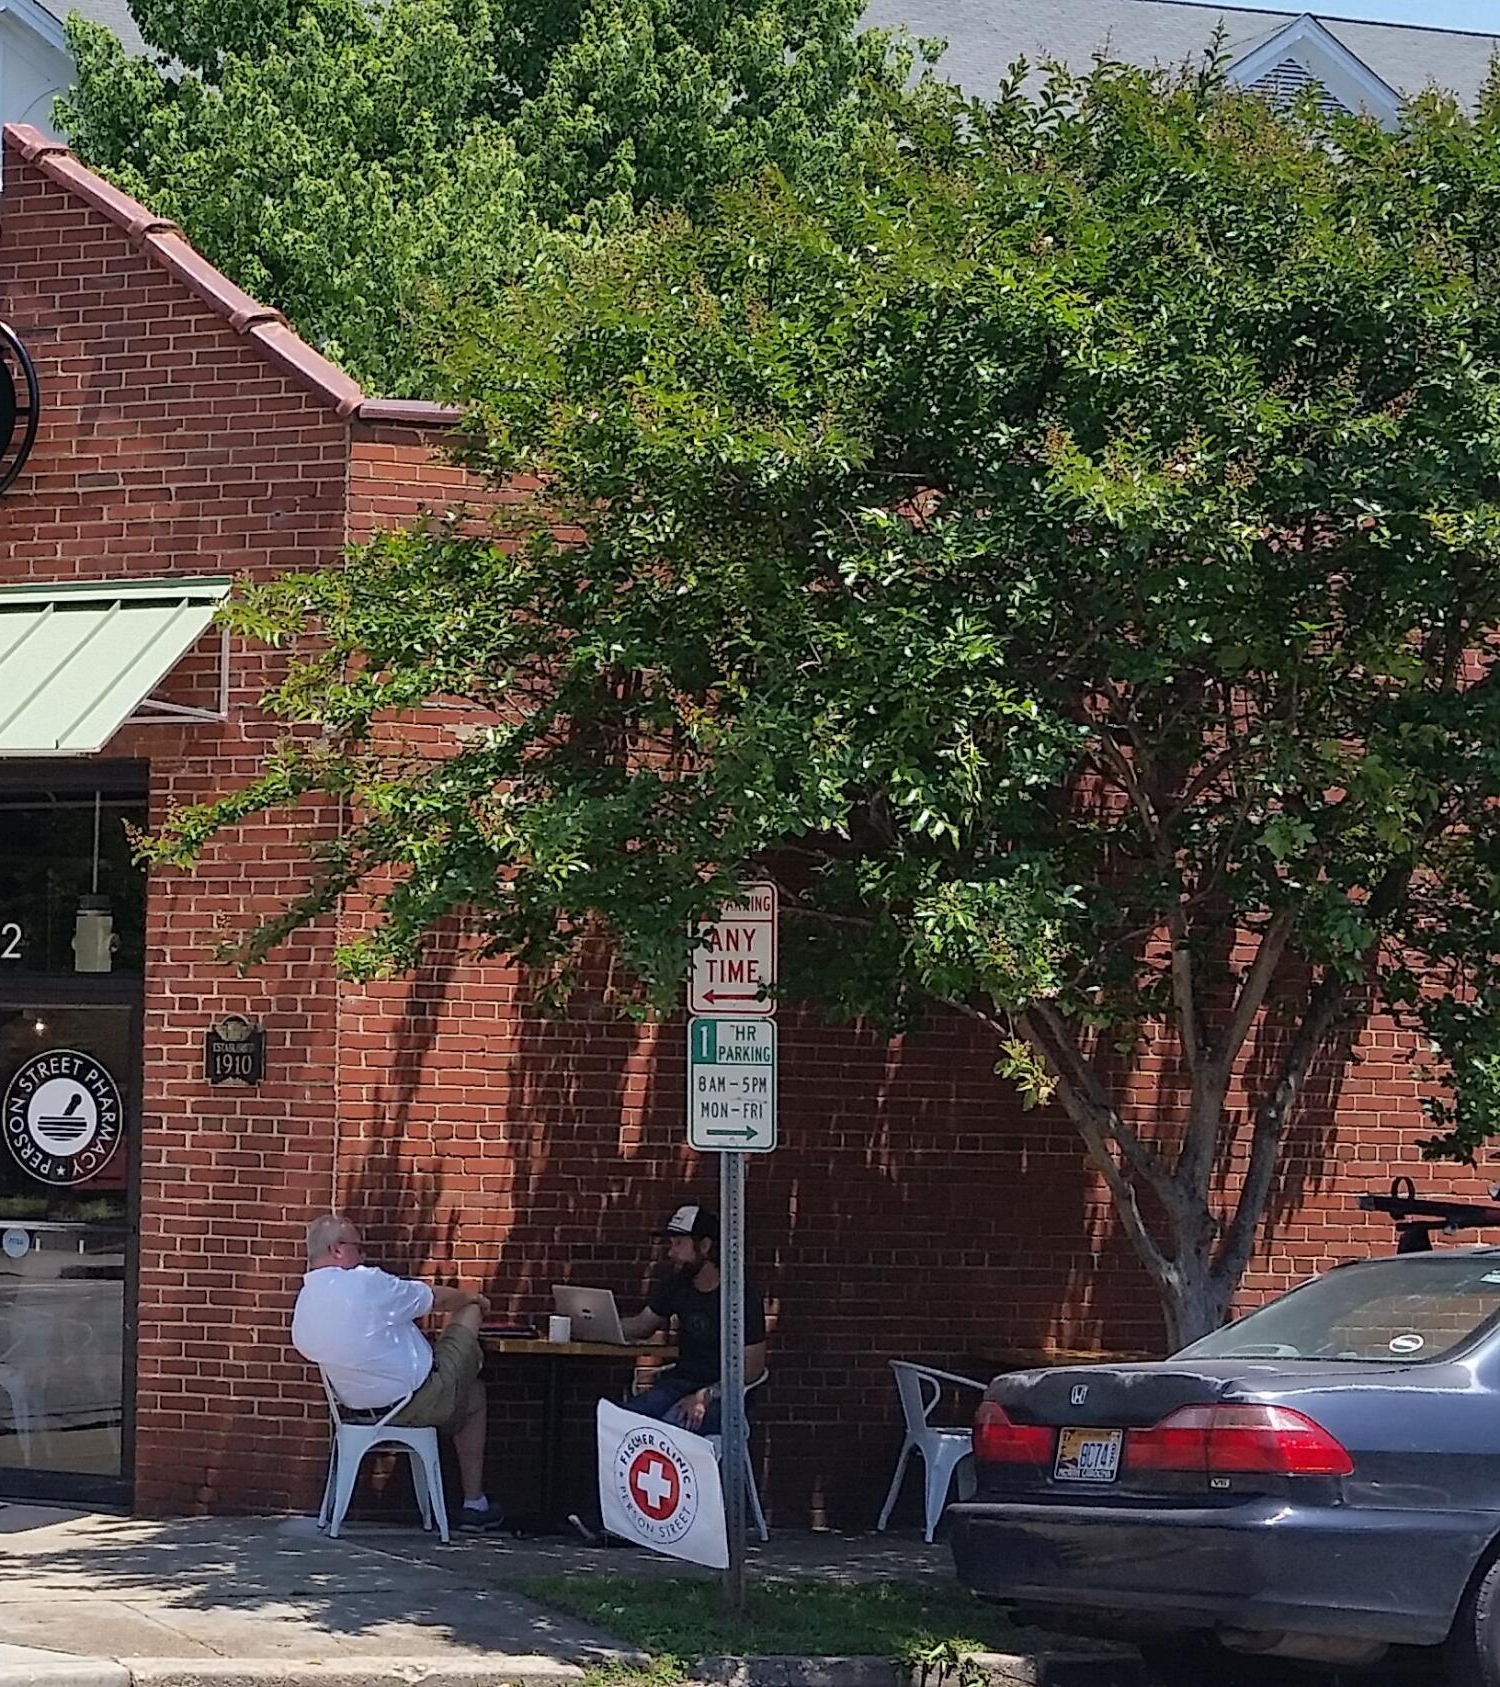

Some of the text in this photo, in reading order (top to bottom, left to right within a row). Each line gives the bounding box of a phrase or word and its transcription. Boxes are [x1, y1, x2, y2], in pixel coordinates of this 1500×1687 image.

[718, 896, 771, 912] ARING
[712, 929, 756, 952] ANY
[706, 960, 760, 983] TIME
[700, 1025, 756, 1057] 1 HR
[215, 1054, 252, 1075] 1910
[719, 1046, 771, 1062] PARKING
[699, 1075, 726, 1092] 8AM
[742, 1076, 767, 1093] 5PM
[9, 1057, 116, 1177] PERSON STREET PHARMACY
[620, 1433, 692, 1484] FISCHER CLINIC
[659, 1506, 692, 1538] STREET
